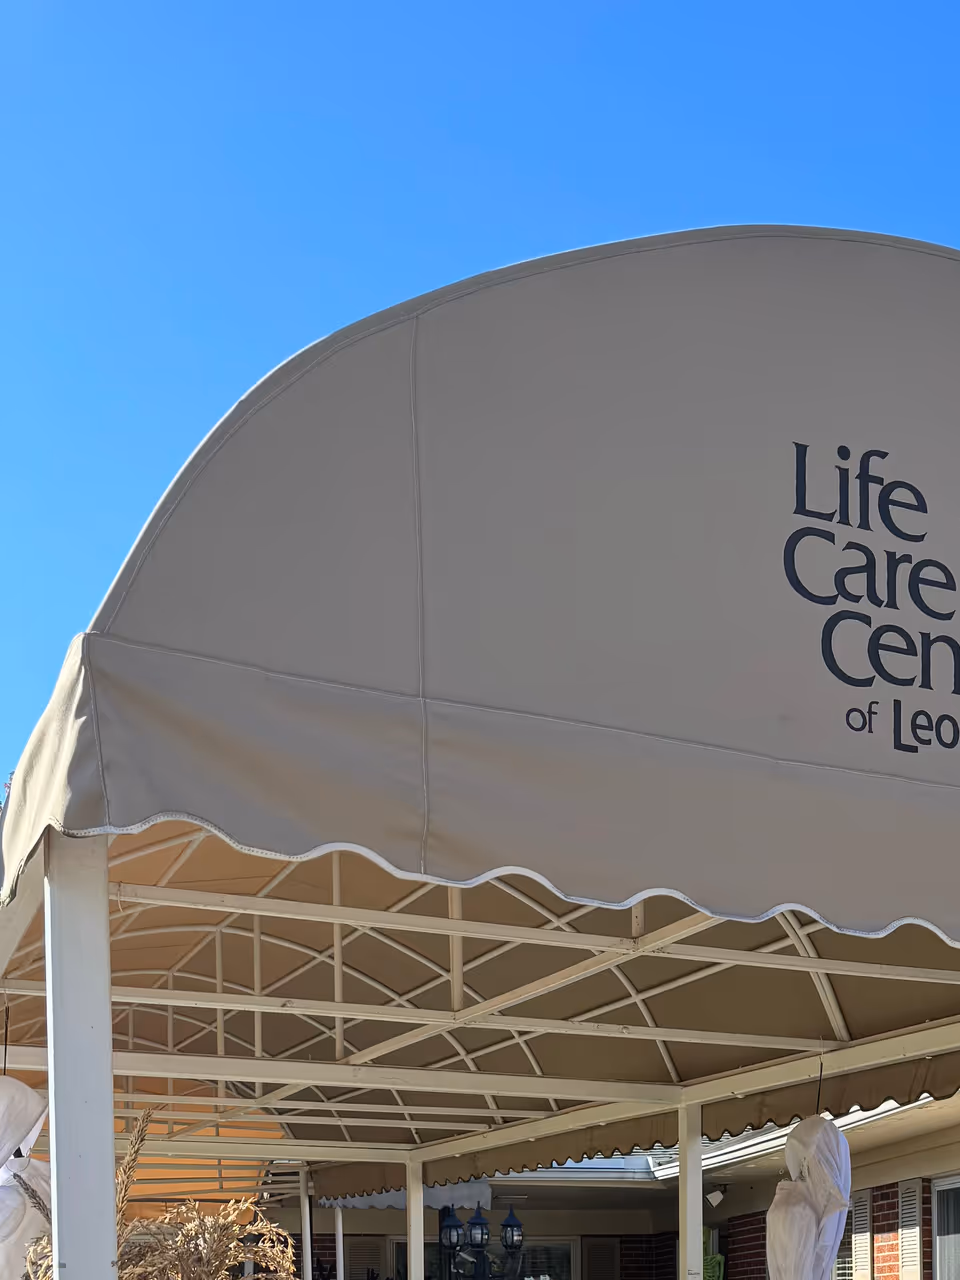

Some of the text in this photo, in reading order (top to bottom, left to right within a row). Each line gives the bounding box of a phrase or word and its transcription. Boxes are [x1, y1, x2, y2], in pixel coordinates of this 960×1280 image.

[792, 441, 928, 543] Life
[783, 526, 957, 621] Care
[845, 700, 880, 734] of
